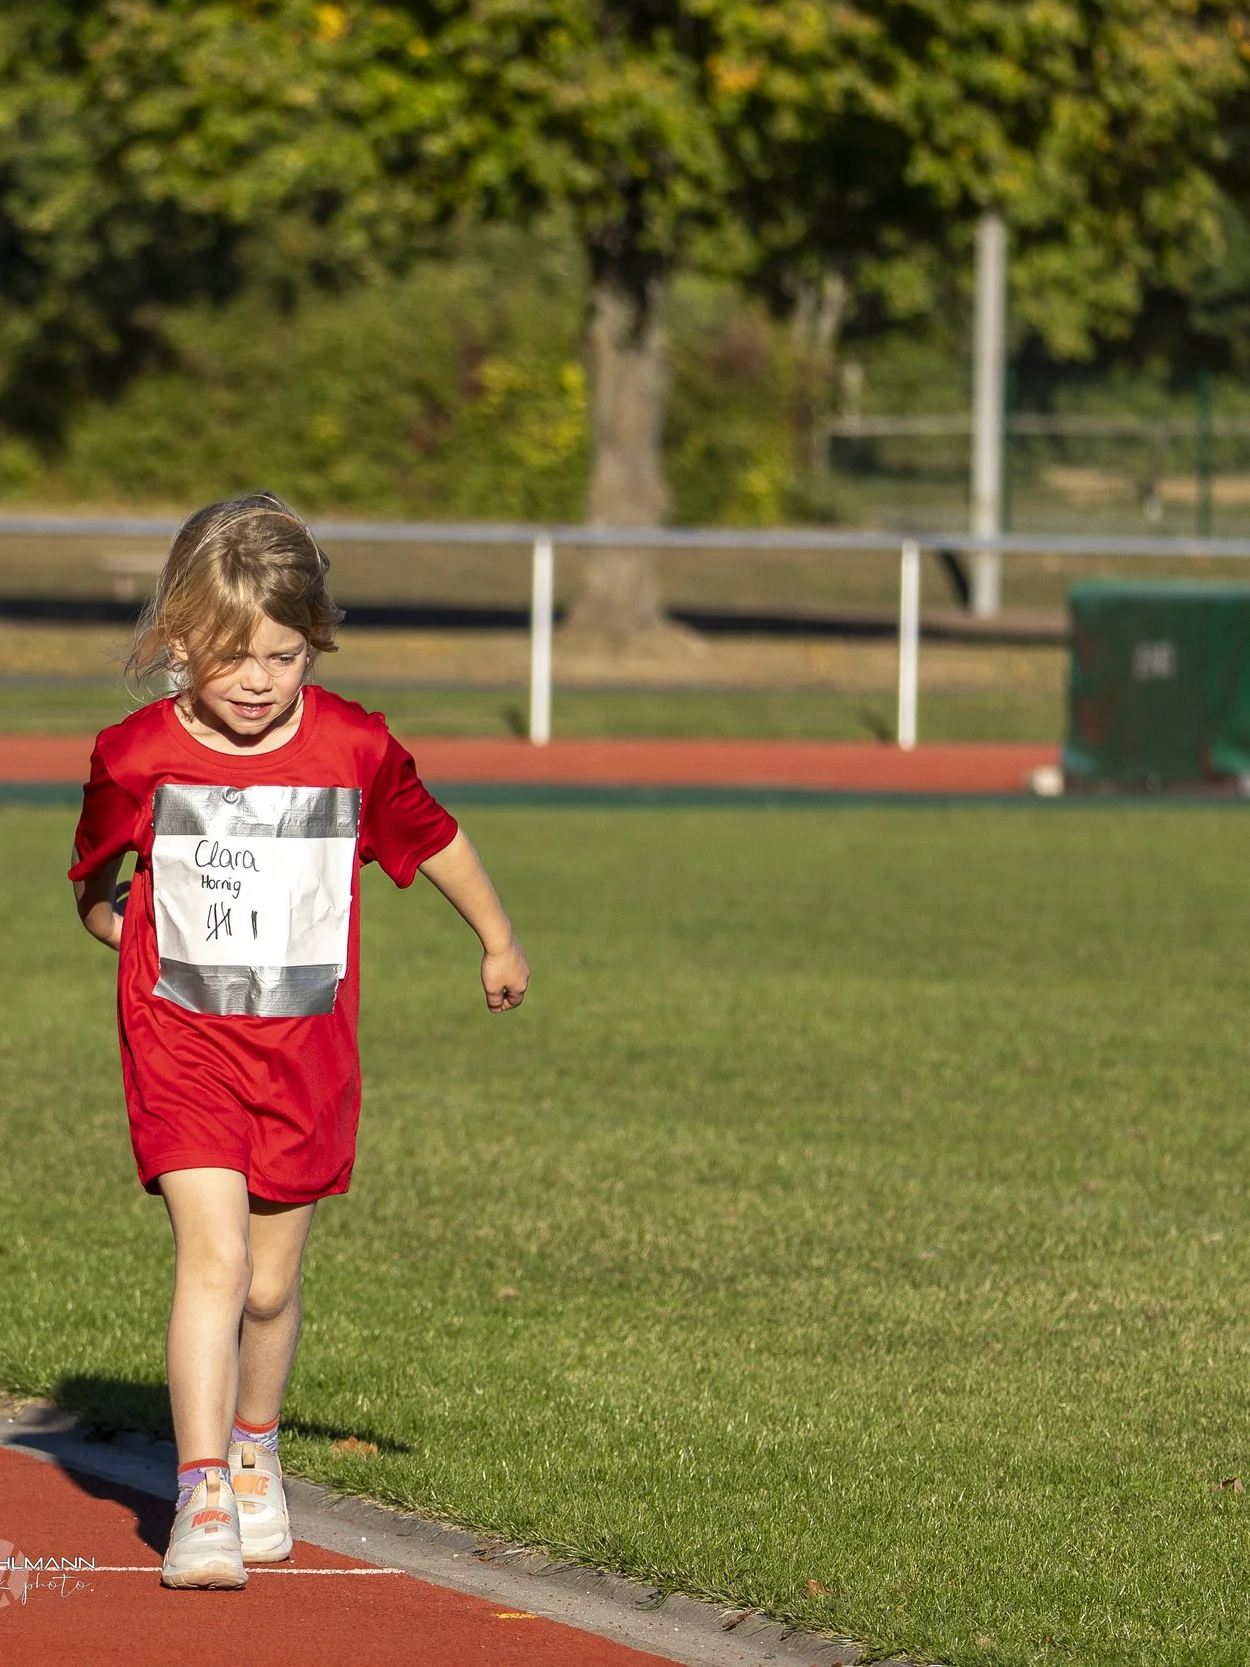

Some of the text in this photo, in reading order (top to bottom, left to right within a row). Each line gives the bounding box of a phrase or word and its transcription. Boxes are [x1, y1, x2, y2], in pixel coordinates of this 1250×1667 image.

[194, 839, 260, 873] Clara
[201, 873, 242, 899] Hornig
[191, 1508, 232, 1529] NIKE
